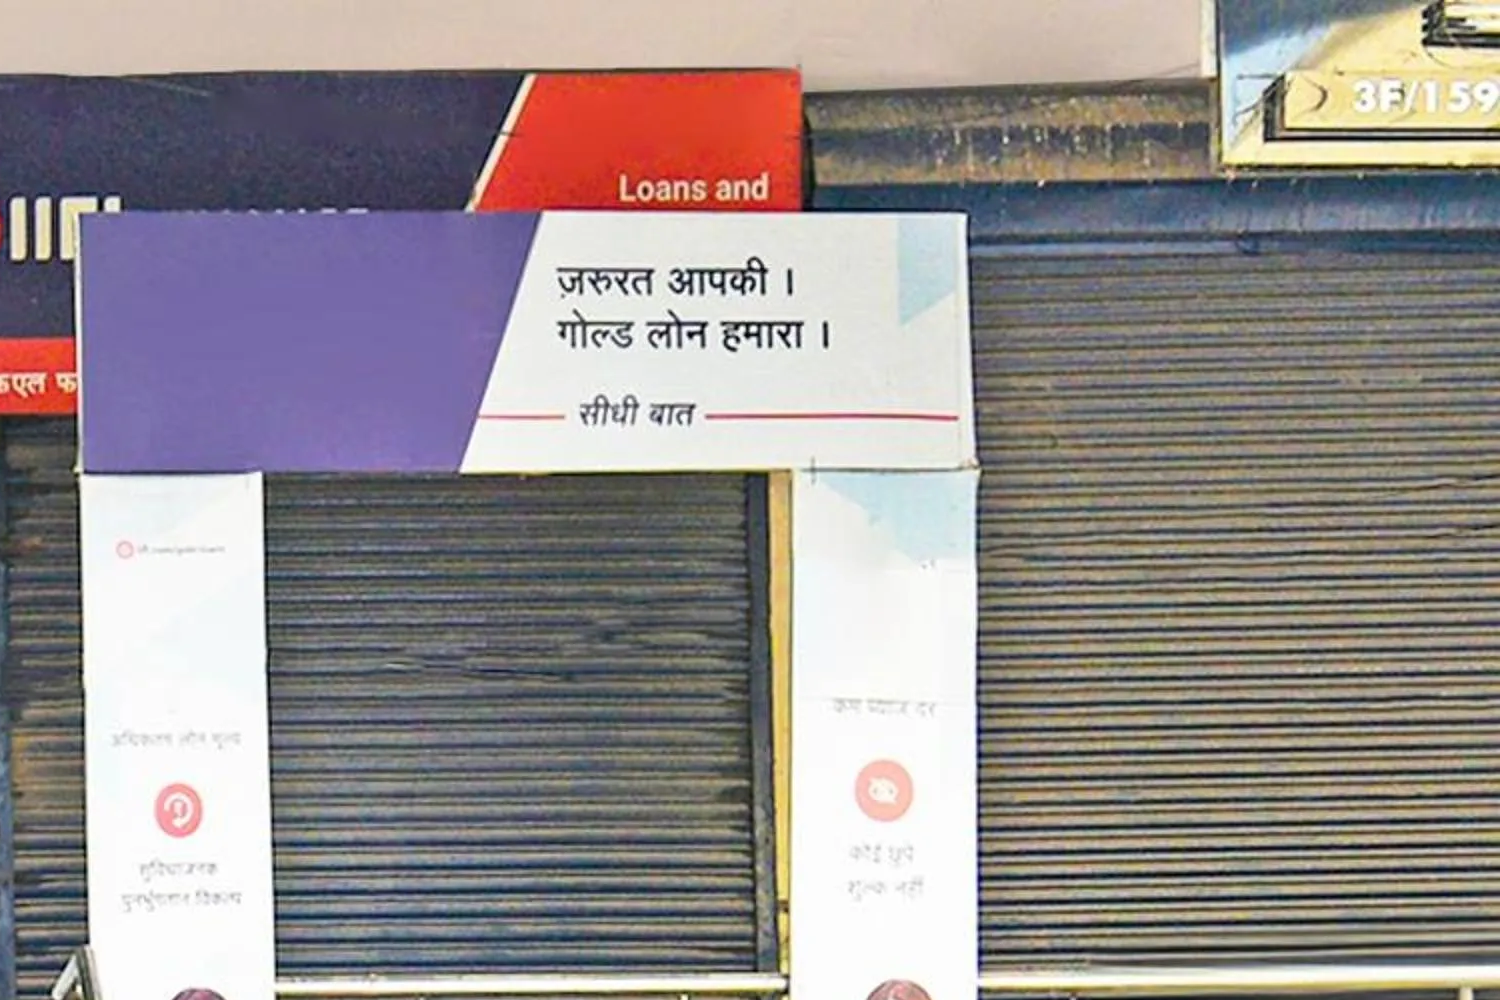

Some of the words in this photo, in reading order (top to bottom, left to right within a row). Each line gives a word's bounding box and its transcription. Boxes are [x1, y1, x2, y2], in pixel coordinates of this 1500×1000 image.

[619, 174, 707, 202] Loans
[716, 173, 769, 201] and
[10, 196, 122, 260] IIF
[667, 256, 768, 295] आपकी
[556, 309, 634, 348] गोल्ड
[647, 309, 708, 348] लोन
[720, 321, 804, 351] हमारा
[579, 394, 639, 426] सीधी
[650, 403, 696, 426] बात
